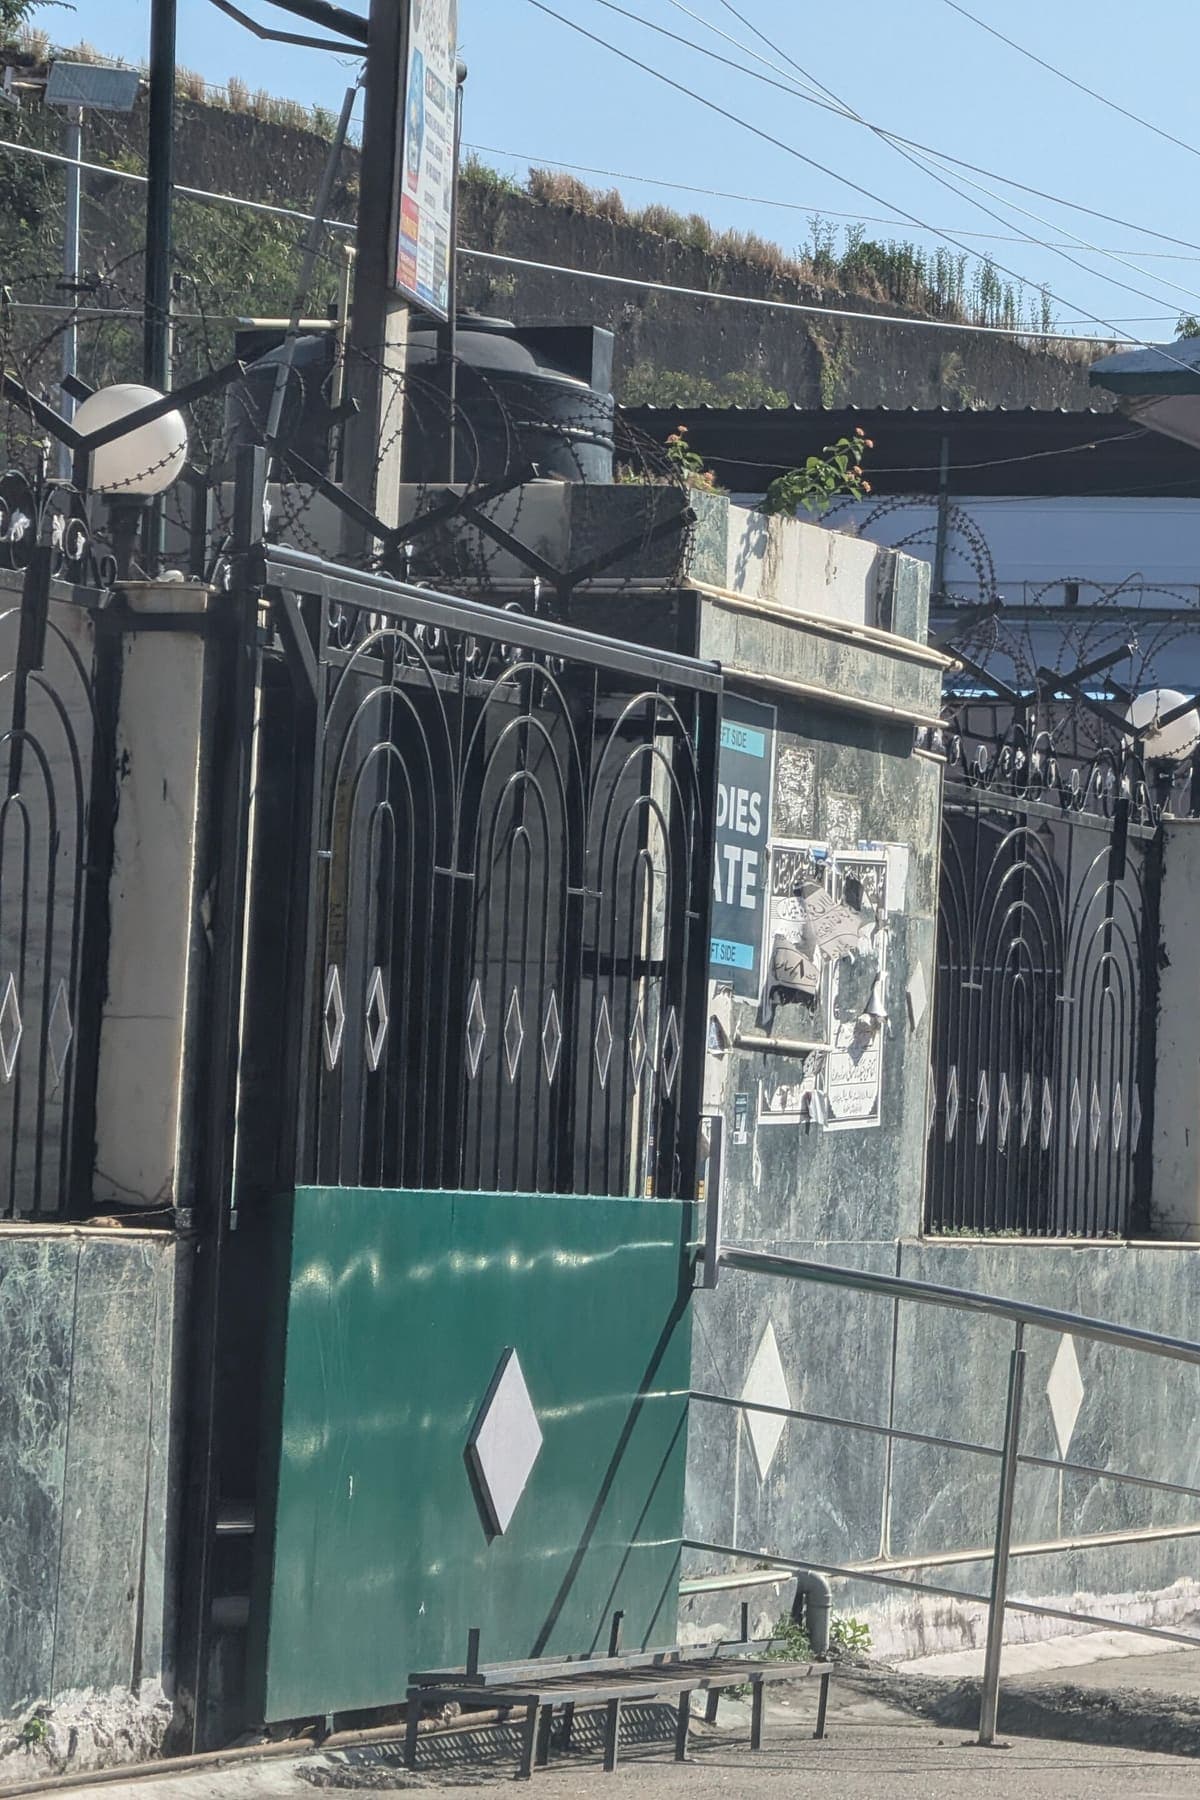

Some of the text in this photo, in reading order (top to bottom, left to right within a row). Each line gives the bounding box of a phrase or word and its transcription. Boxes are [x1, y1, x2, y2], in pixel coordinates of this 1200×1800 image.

[731, 729, 748, 749] SIDE
[716, 783, 762, 837] DIES
[720, 944, 737, 962] SIDE
